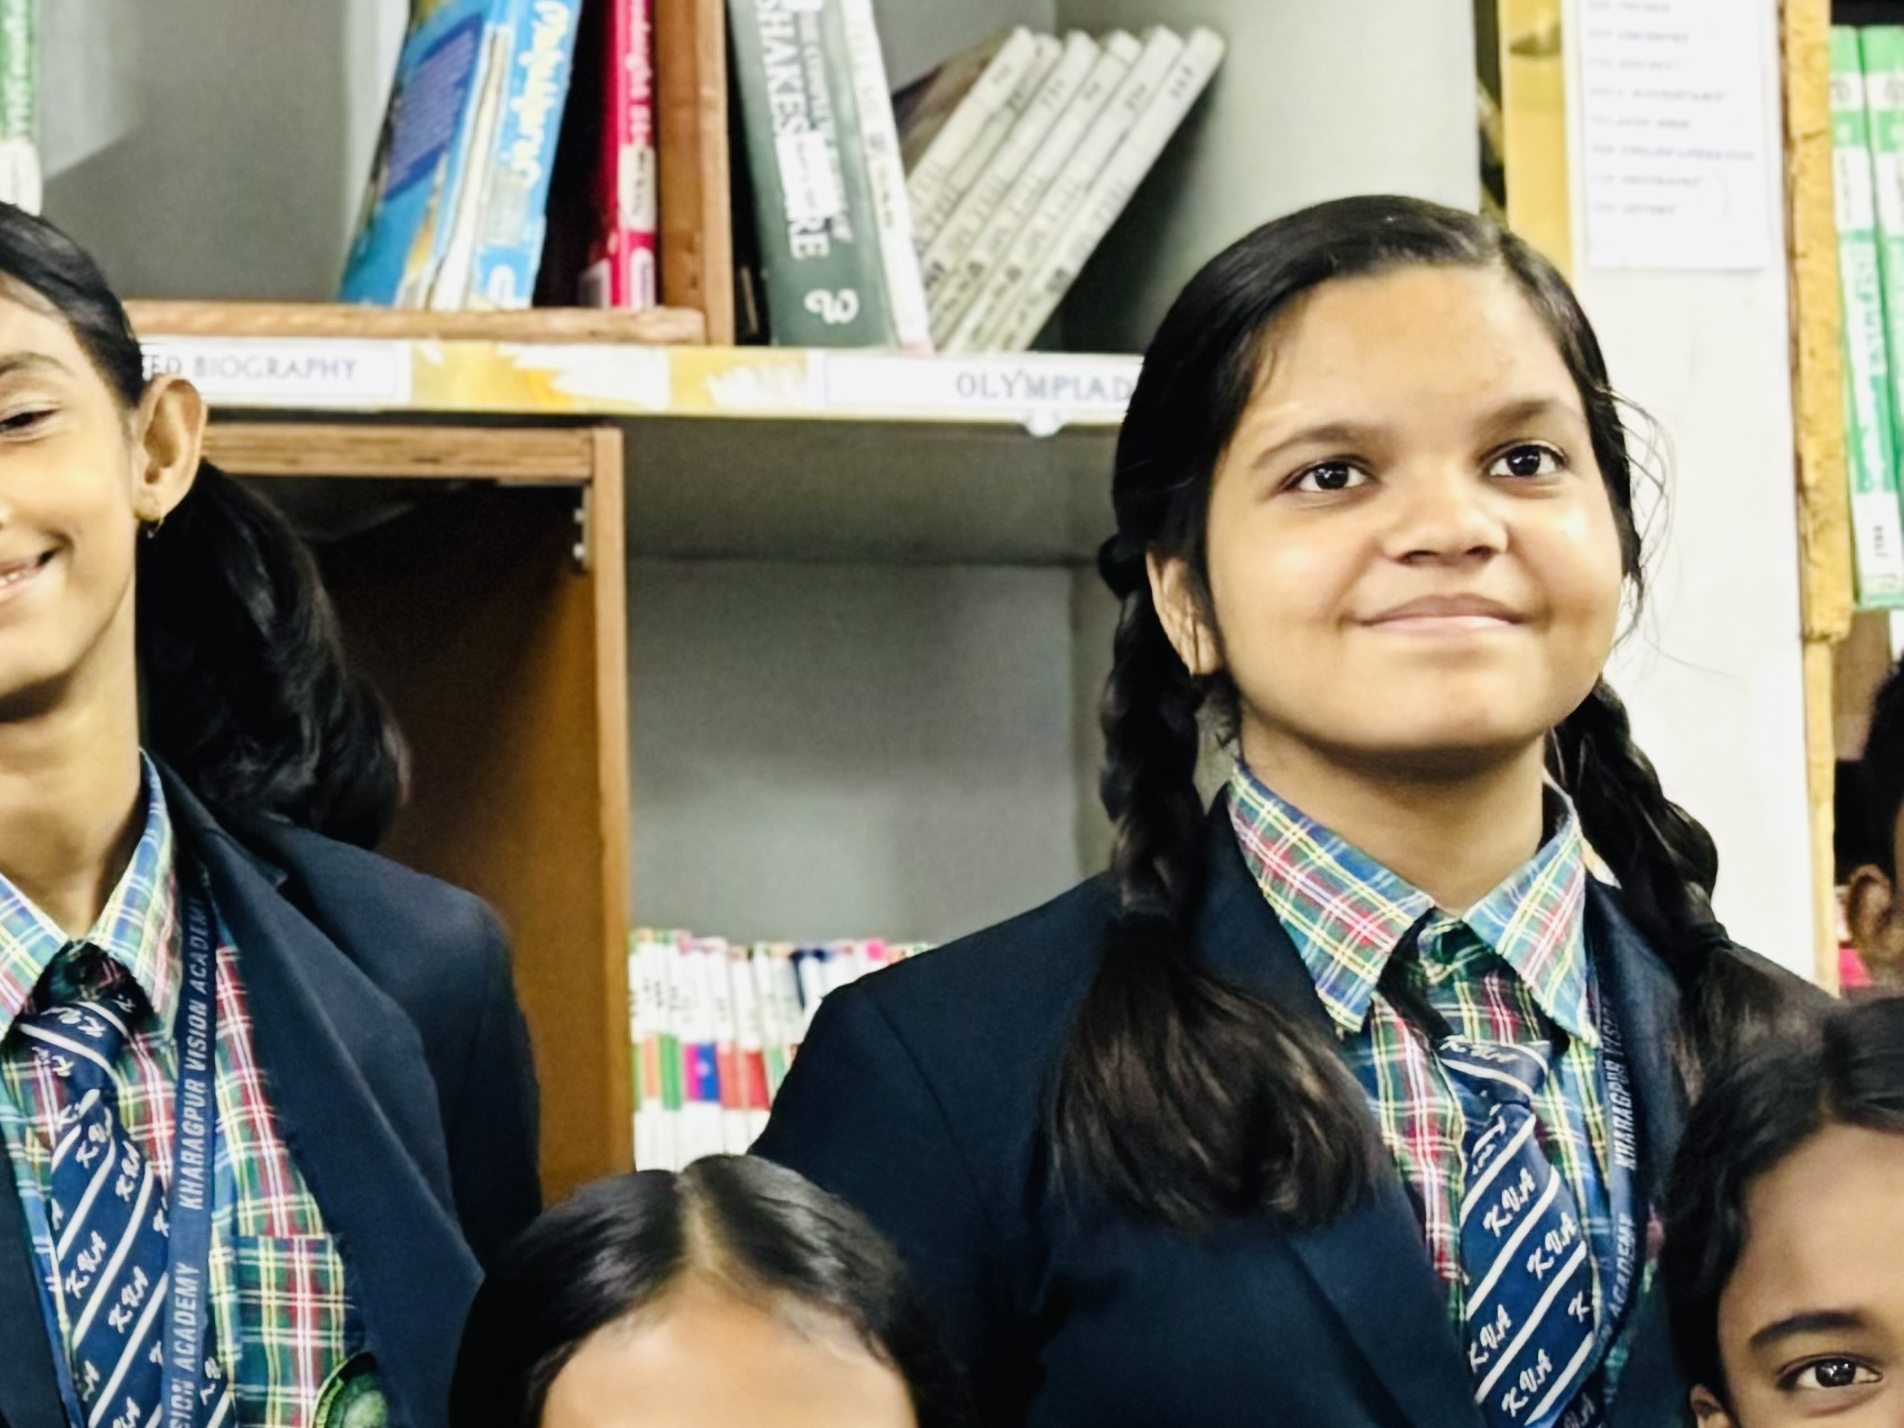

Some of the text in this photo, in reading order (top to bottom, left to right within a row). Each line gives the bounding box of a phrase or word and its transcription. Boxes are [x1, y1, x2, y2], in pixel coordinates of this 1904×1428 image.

[193, 356, 358, 382] BIOGRAPHY
[184, 1000, 207, 1072] VISION
[178, 1079, 205, 1210] KHARAGPUR
[173, 1261, 201, 1372] ACADEMY
